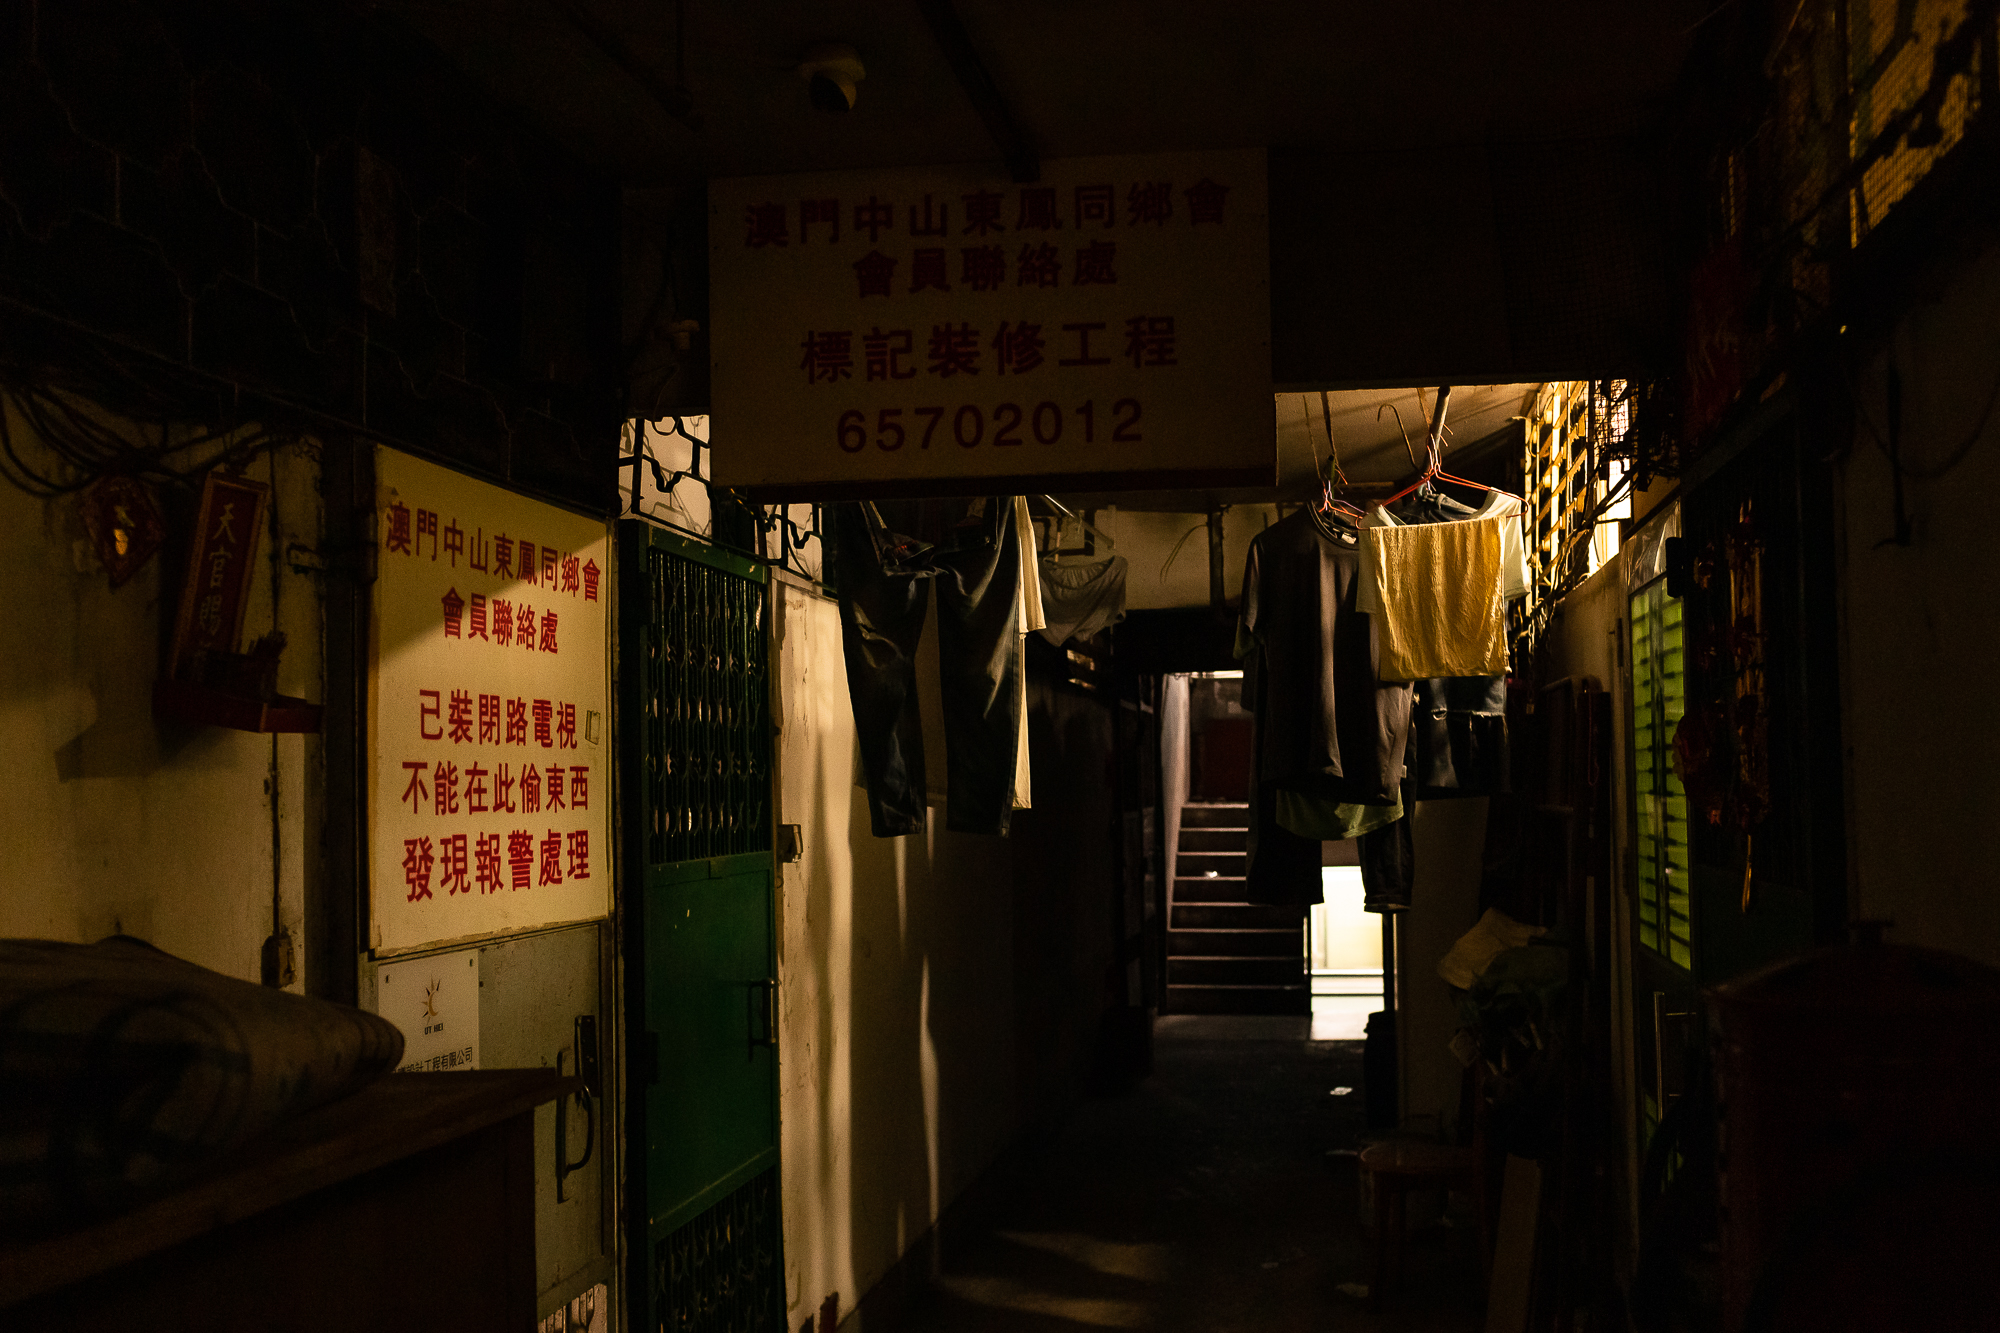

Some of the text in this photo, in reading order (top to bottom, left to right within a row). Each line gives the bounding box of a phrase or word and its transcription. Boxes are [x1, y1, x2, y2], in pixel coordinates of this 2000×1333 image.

[744, 177, 1230, 248] 澳門中山東鳳同鄉會
[852, 240, 1118, 298] 會員聯絡處
[801, 316, 1178, 384] 標記裝修工程
[837, 398, 1143, 453] 65702012
[386, 501, 601, 603] 澳門中山東鳳同鄉會
[441, 586, 558, 654] 會員聯絡處
[419, 689, 577, 750] 已裝閉路電視
[401, 760, 590, 816] 不能在此偷東西
[401, 828, 590, 902] 發現報警處理
